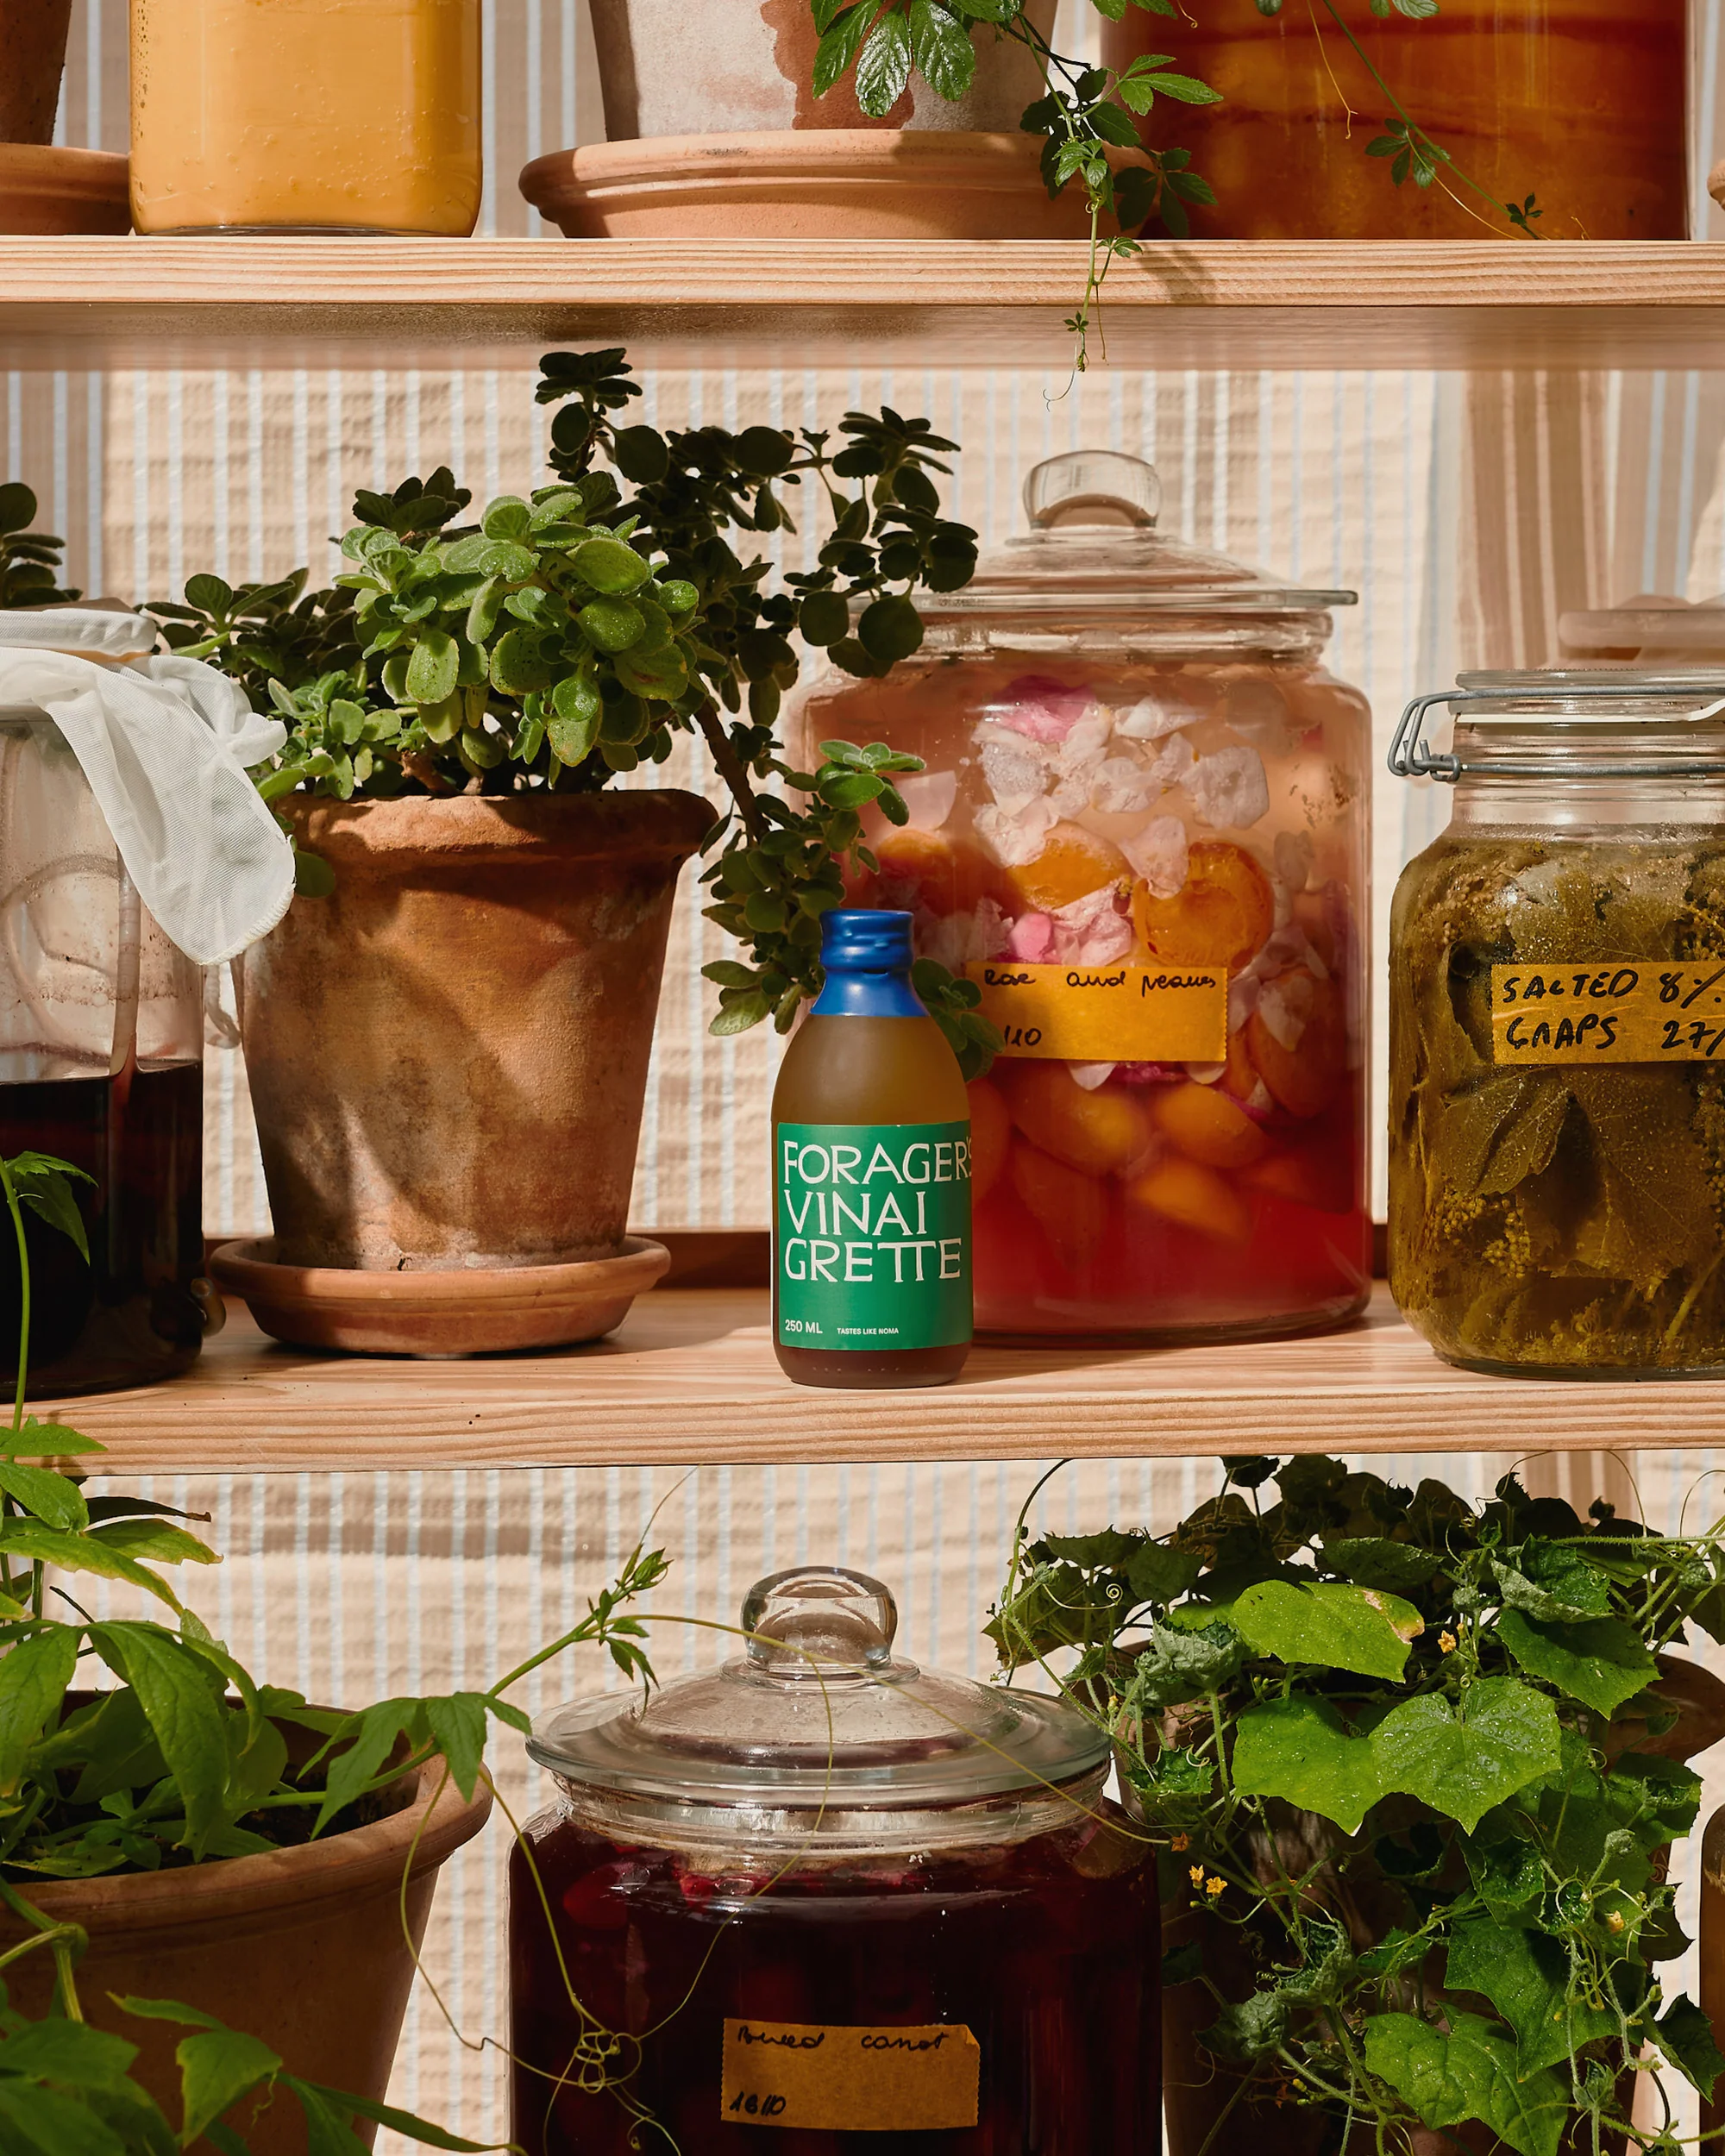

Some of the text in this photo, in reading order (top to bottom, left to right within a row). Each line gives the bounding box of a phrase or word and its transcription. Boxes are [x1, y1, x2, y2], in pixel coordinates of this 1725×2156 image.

[783, 1189, 928, 1236] VINAI
[784, 1238, 963, 1283] GRETTE
[785, 1319, 823, 1334] 250 ML
